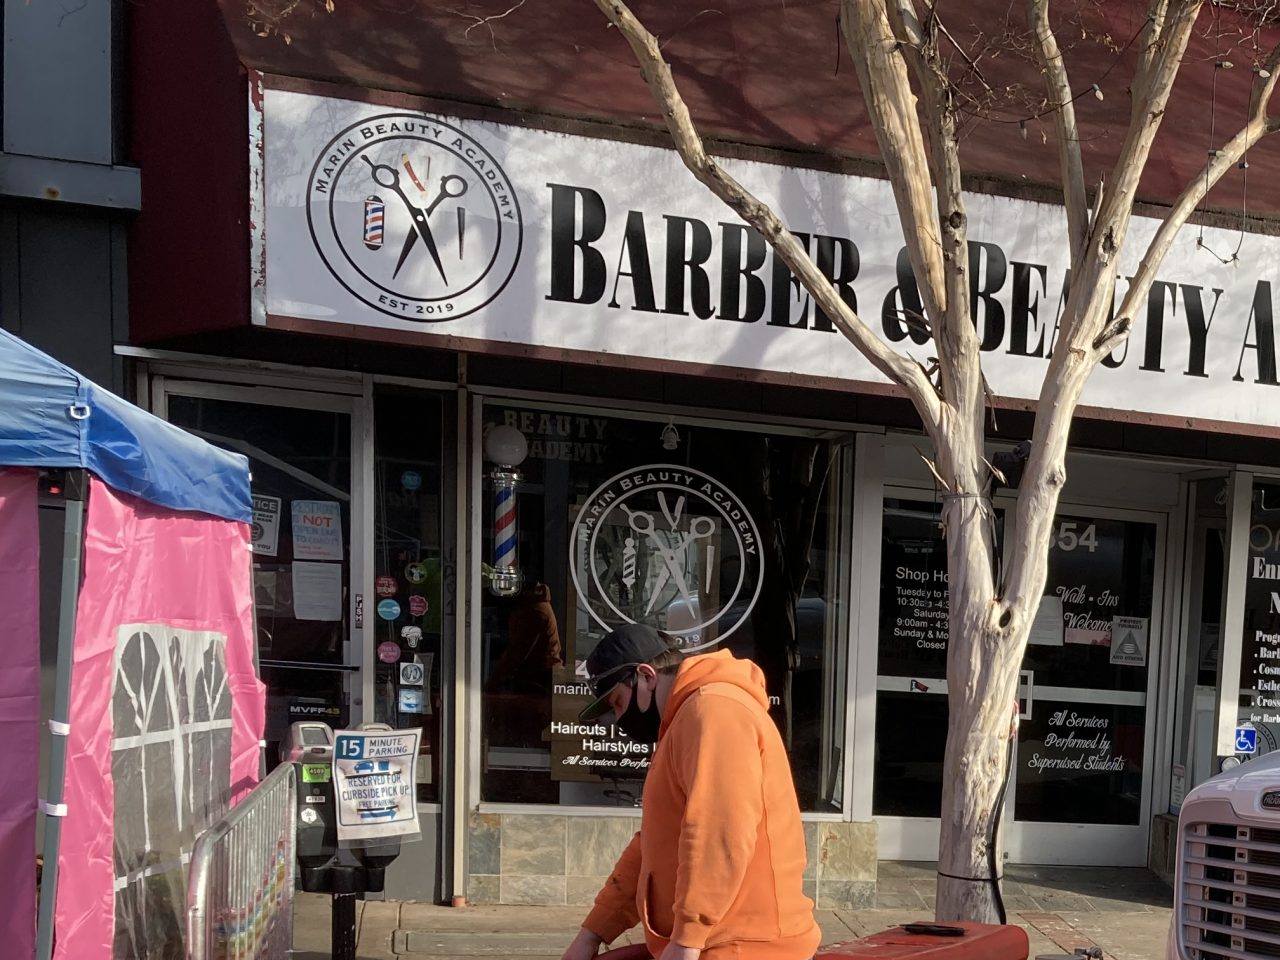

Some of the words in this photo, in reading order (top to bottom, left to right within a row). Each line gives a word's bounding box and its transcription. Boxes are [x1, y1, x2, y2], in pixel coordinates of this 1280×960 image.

[315, 138, 356, 194] MARIN
[360, 122, 443, 141] BEAUTY
[451, 138, 514, 220] ACADEMY
[545, 182, 861, 334] BARBER
[378, 294, 409, 312] EST
[415, 302, 455, 315] 2019
[504, 410, 608, 440] BEAUTY
[253, 500, 278, 511] TICE
[578, 490, 616, 542] MARIN
[619, 471, 694, 491] BEAUTY
[700, 483, 756, 555] ACADEMY
[303, 514, 333, 528] NOT
[895, 566, 929, 584] Shop
[933, 570, 949, 583] Ho
[896, 586, 931, 599] Tuesday
[934, 589, 942, 598] to
[1056, 584, 1086, 605] Walk
[1097, 589, 1120, 607] Ins
[913, 608, 950, 621] Saturday
[1063, 611, 1113, 632] Welcome
[897, 618, 928, 628] 9:00am
[935, 620, 949, 629] 4:3
[674, 633, 700, 646] 019
[894, 628, 925, 640] Sunday
[927, 629, 934, 639] &
[936, 631, 949, 640] Mo
[916, 640, 946, 650] Closed
[553, 684, 592, 696] marin
[1048, 709, 1065, 726] All
[1066, 712, 1109, 729] Services
[1251, 713, 1262, 723] for
[551, 721, 606, 736] Haircuts
[341, 739, 361, 757] 15
[369, 738, 403, 747] MINUTE
[368, 746, 408, 756] PARKING
[582, 738, 649, 755] Hairstyles
[1044, 731, 1097, 751] Performed
[1099, 733, 1111, 756] by
[562, 755, 578, 766] All
[579, 755, 617, 768] Services
[620, 757, 652, 770] Perfor
[1028, 752, 1084, 774] Supervised
[1083, 755, 1128, 772] Students
[348, 775, 386, 787] RESERVED
[387, 774, 401, 785] FOR
[342, 787, 380, 801] CURBSIDE
[381, 786, 397, 797] PICK
[400, 785, 410, 795] UP
[358, 800, 373, 808] FREE
[373, 798, 396, 807] PARKING
